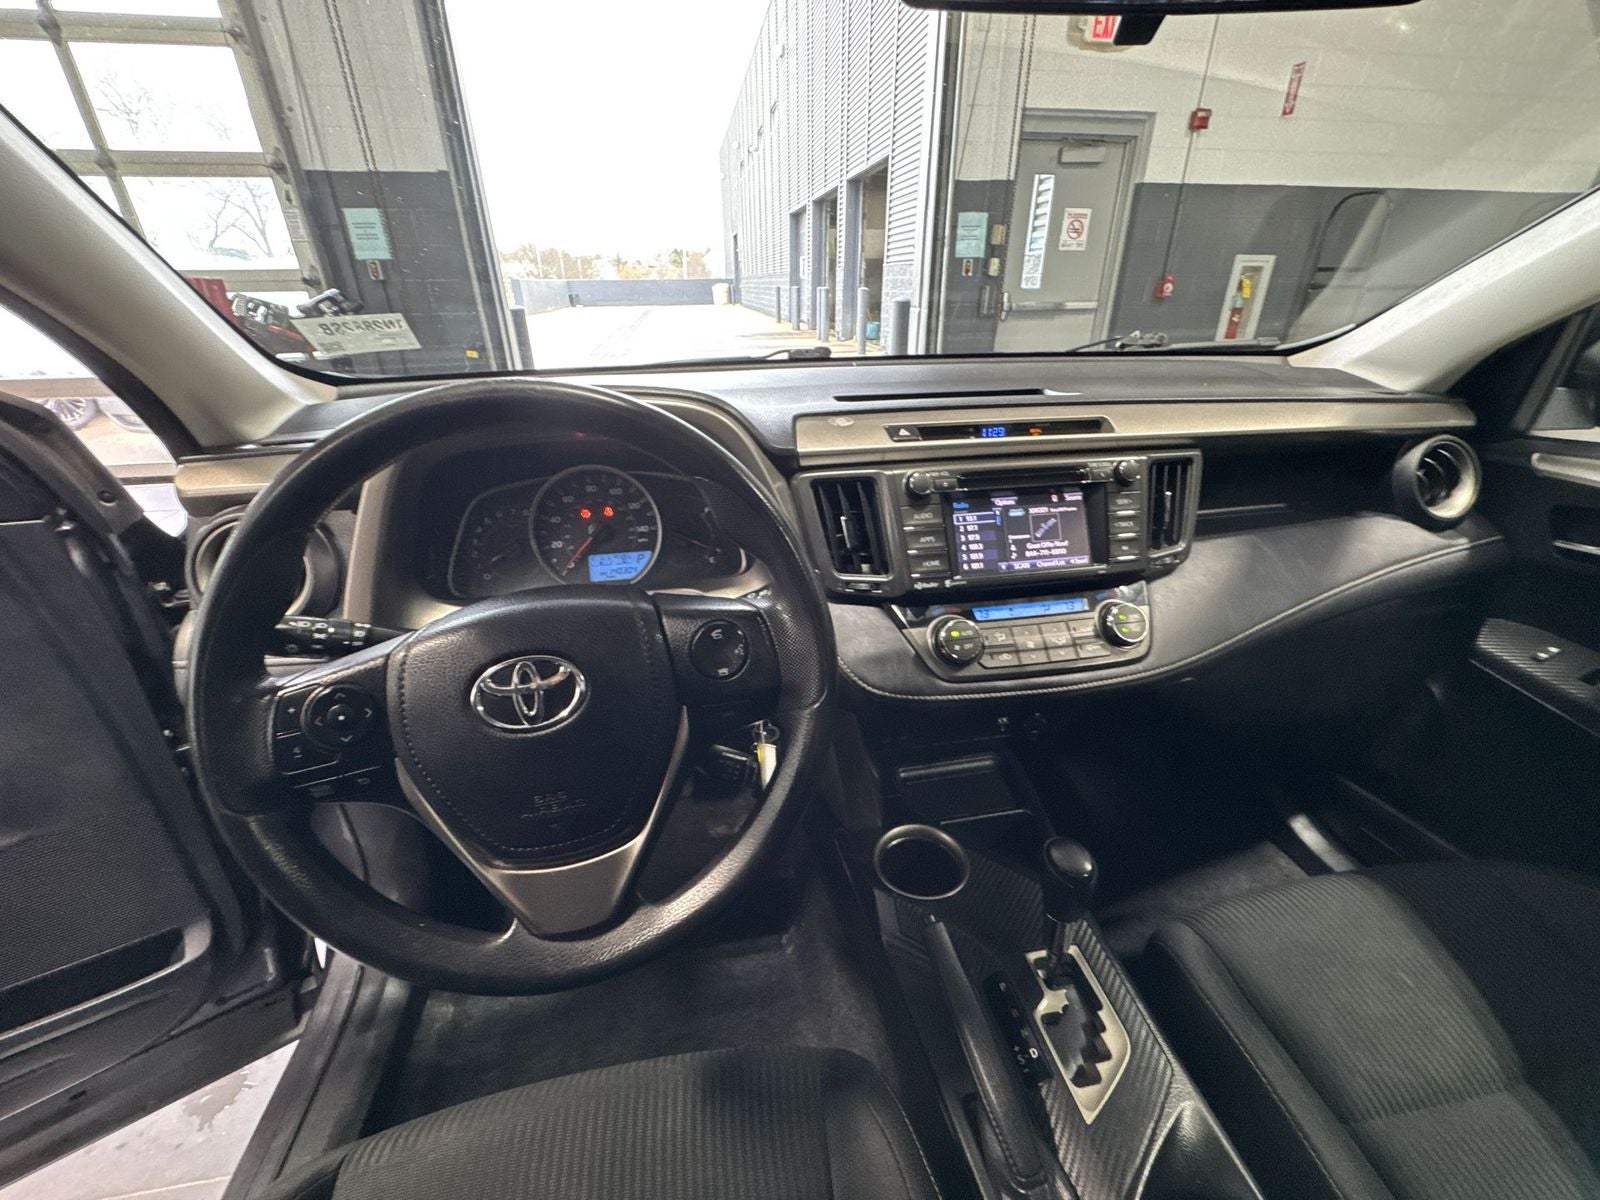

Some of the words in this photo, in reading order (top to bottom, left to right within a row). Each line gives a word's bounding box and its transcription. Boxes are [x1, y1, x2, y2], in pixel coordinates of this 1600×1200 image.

[913, 512, 933, 520] AUDIO
[637, 554, 645, 563] P
[1029, 1048, 1039, 1059] D
